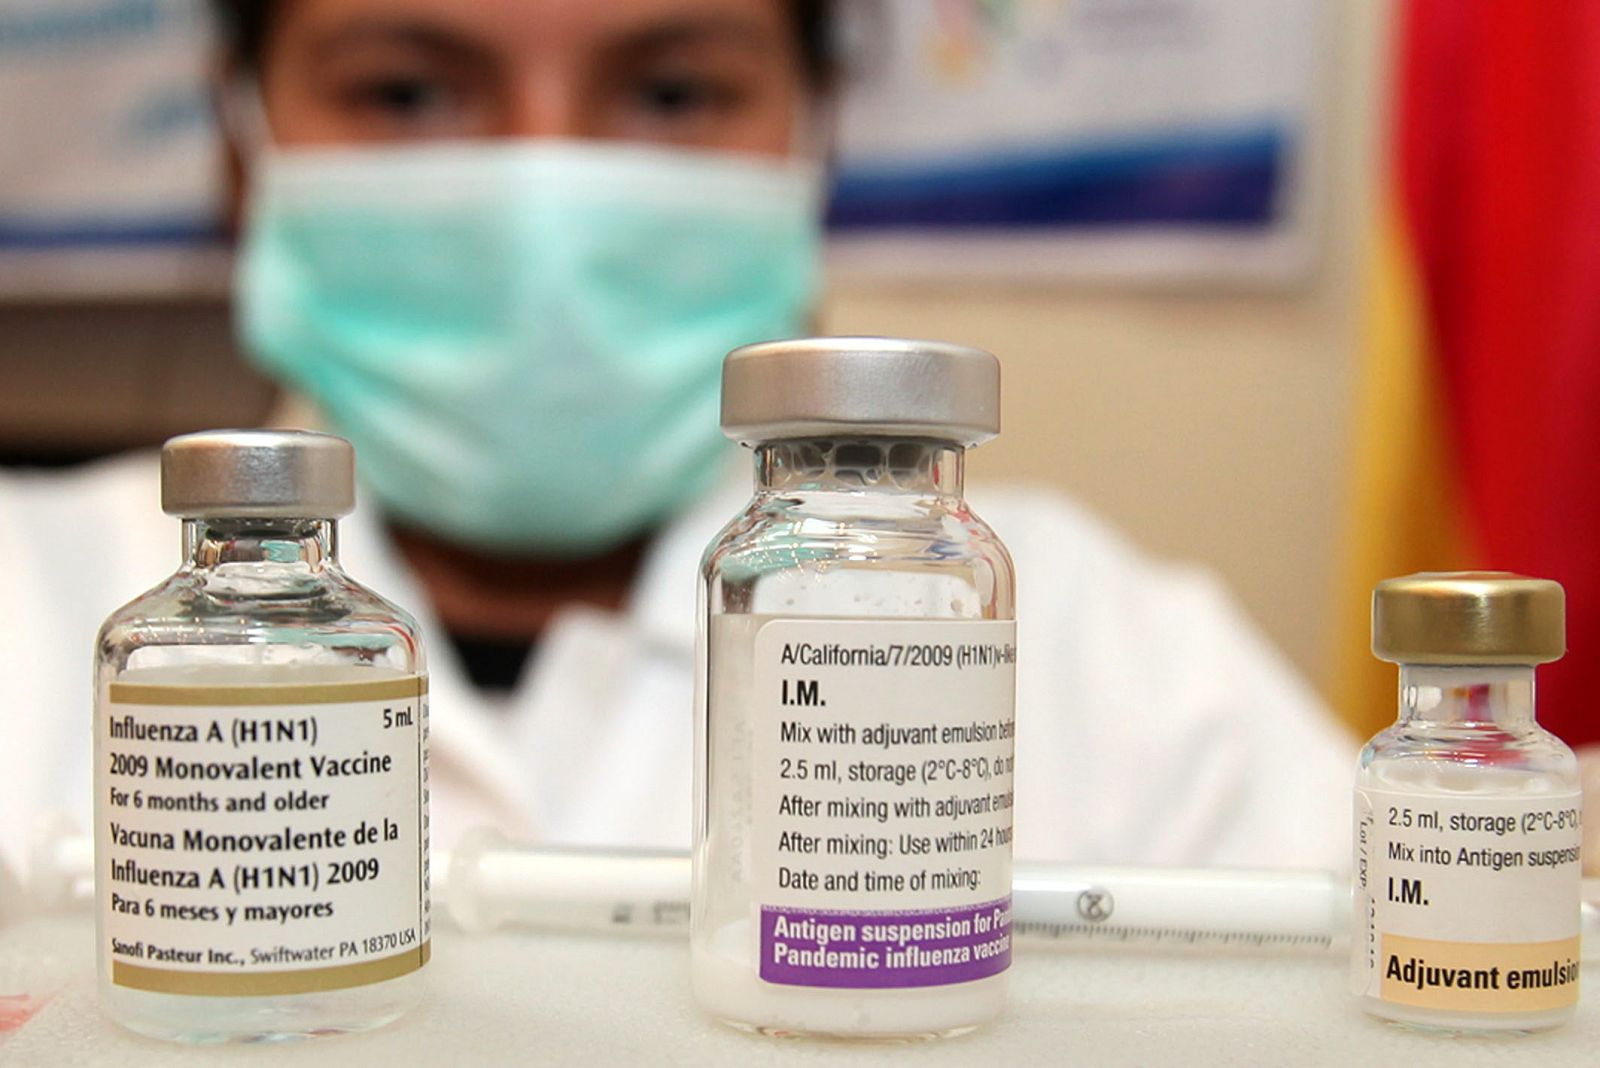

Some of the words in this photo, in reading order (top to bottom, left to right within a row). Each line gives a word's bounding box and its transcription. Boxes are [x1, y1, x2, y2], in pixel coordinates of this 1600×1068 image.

[781, 644, 952, 666] A/California/7/2009
[782, 680, 826, 706] I.M.
[110, 716, 198, 743] Influenza
[207, 721, 223, 742] A
[231, 717, 318, 747] (H1N1)
[383, 709, 392, 728] 5
[396, 707, 412, 727] mL
[781, 722, 811, 743] Mix
[818, 723, 856, 744] with
[862, 724, 936, 749] adjuvant
[942, 720, 996, 744] emulsion
[110, 753, 148, 776] 2009
[156, 757, 301, 779] Monovalent
[310, 751, 391, 777] Vaccine
[781, 759, 808, 779] 2.5
[815, 760, 842, 782] ml,
[849, 762, 916, 785] storage
[110, 788, 129, 807] For
[135, 791, 143, 808] 6
[148, 793, 219, 812] months
[226, 792, 265, 812] and
[274, 792, 329, 810] older
[779, 795, 822, 817] After
[827, 797, 888, 822] mixing
[894, 798, 930, 817] with
[935, 794, 991, 820] adjuvant
[111, 822, 174, 849] Vacuna
[183, 828, 346, 851] Monovalente
[354, 822, 377, 845] de
[384, 818, 398, 841] la
[1389, 807, 1412, 827] 2.5
[1418, 811, 1443, 832] ml,
[1450, 813, 1515, 835] storage
[778, 832, 821, 853] After
[827, 834, 892, 859] mixing:
[900, 834, 931, 855] Use
[935, 831, 977, 852] within
[980, 830, 993, 848] 24
[1389, 842, 1414, 861] Mix
[1420, 845, 1451, 865] into
[1457, 848, 1522, 870] Antigen
[111, 859, 200, 888] Influenza
[208, 868, 225, 888] A
[233, 863, 319, 894] (H1N1)
[327, 858, 379, 885] 2009
[779, 868, 819, 889] Date
[825, 871, 858, 892] and
[865, 871, 904, 892] time
[910, 869, 926, 890] of
[932, 869, 981, 890] mixing:
[1388, 877, 1429, 905] I.M.
[112, 894, 139, 915] Para
[145, 899, 154, 916] 6
[160, 904, 219, 921] meses
[226, 907, 237, 925] y
[245, 902, 333, 924] mayores
[774, 916, 855, 944] Antigen
[862, 918, 970, 945] suspension
[974, 911, 991, 933] for
[112, 938, 143, 957] Sanofi
[147, 946, 202, 964] Pasteur
[208, 950, 245, 966] Inc.,
[251, 948, 334, 964] Swiftwater
[340, 942, 357, 956] PA
[362, 934, 397, 953] 18370
[399, 928, 416, 944] USA
[774, 943, 879, 969] Pandemic
[885, 947, 970, 968] influenza
[1386, 955, 1499, 989] Adjuvant
